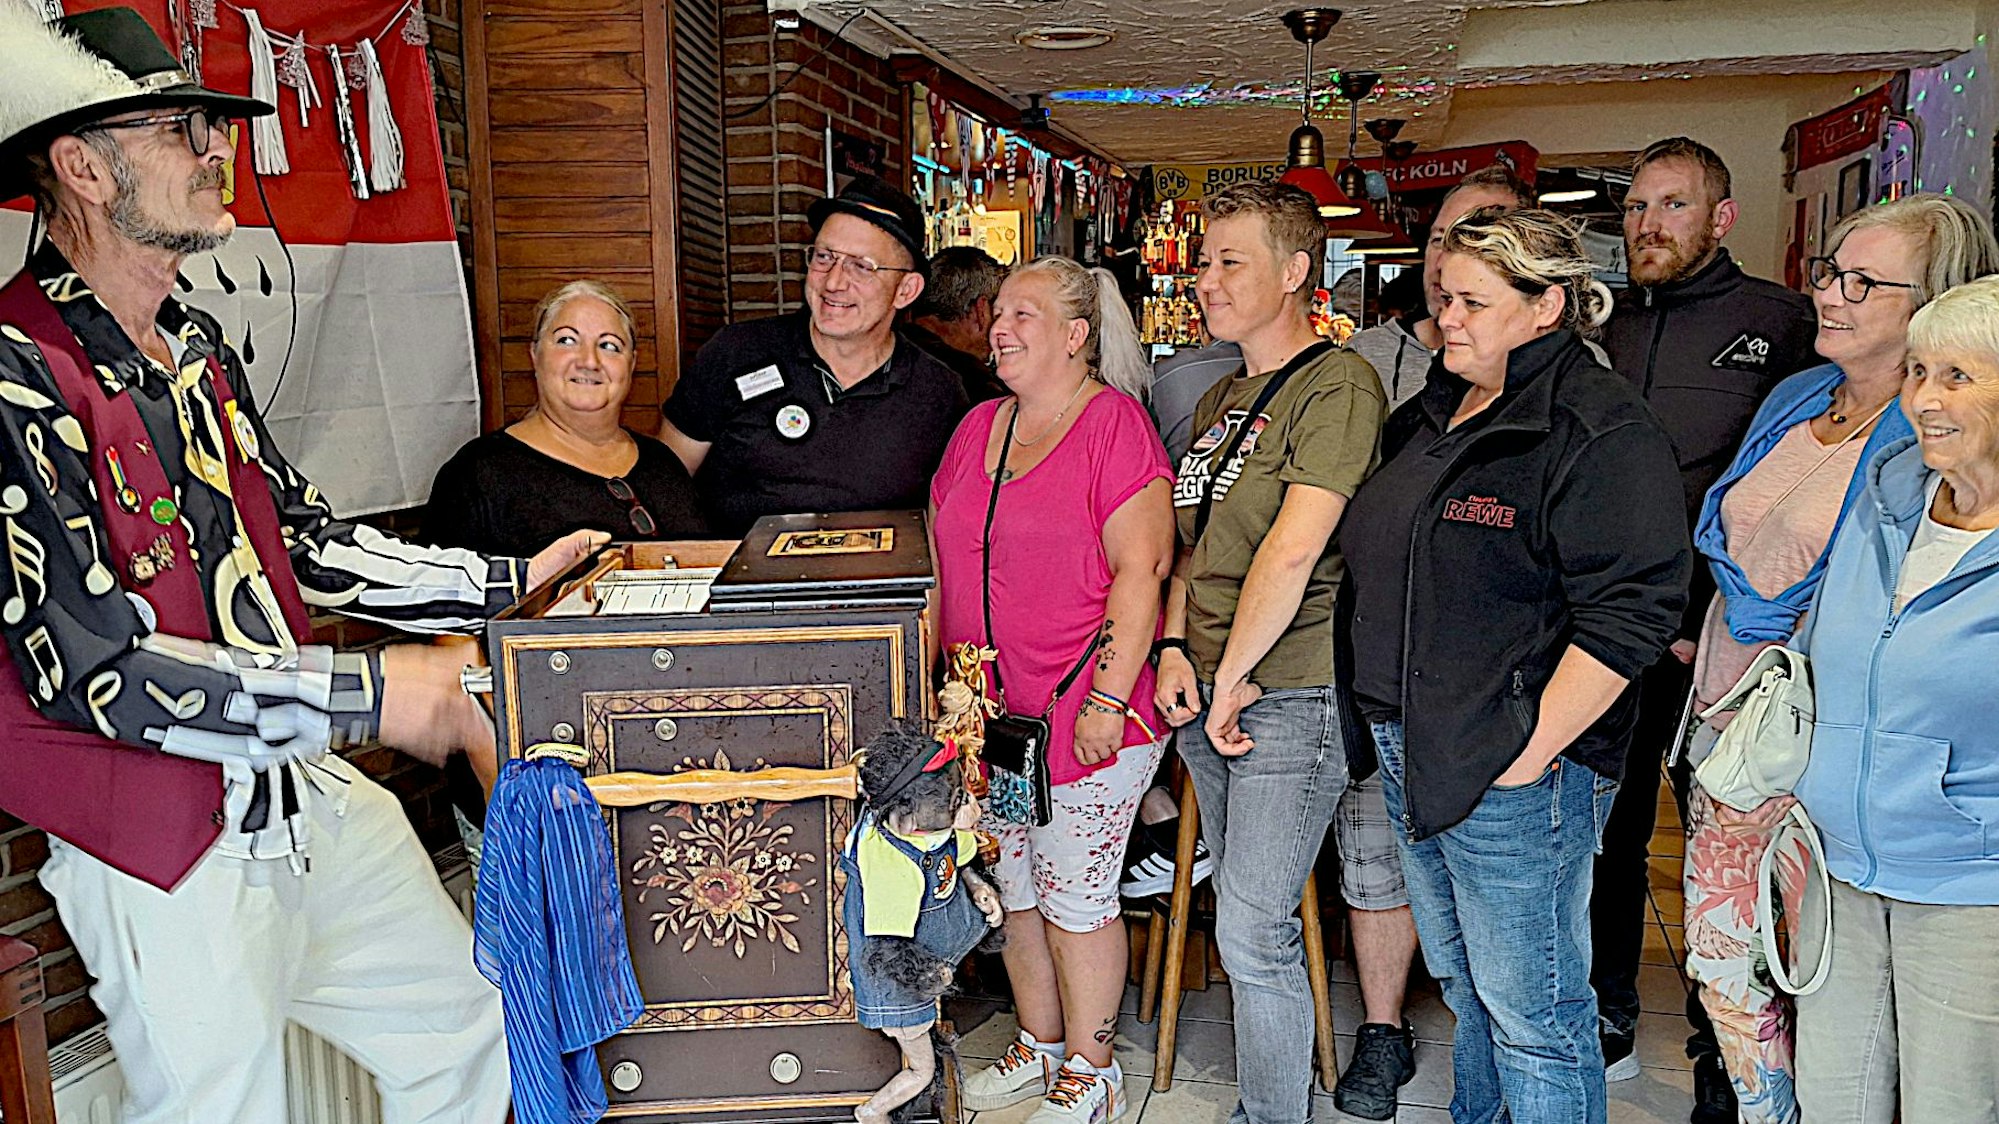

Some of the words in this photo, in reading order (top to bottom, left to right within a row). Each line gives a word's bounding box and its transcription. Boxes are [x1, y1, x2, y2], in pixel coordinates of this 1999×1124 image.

[1159, 171, 1186, 189] BVB
[1409, 159, 1468, 180] KÖLN
[1443, 498, 1516, 528] REWE
